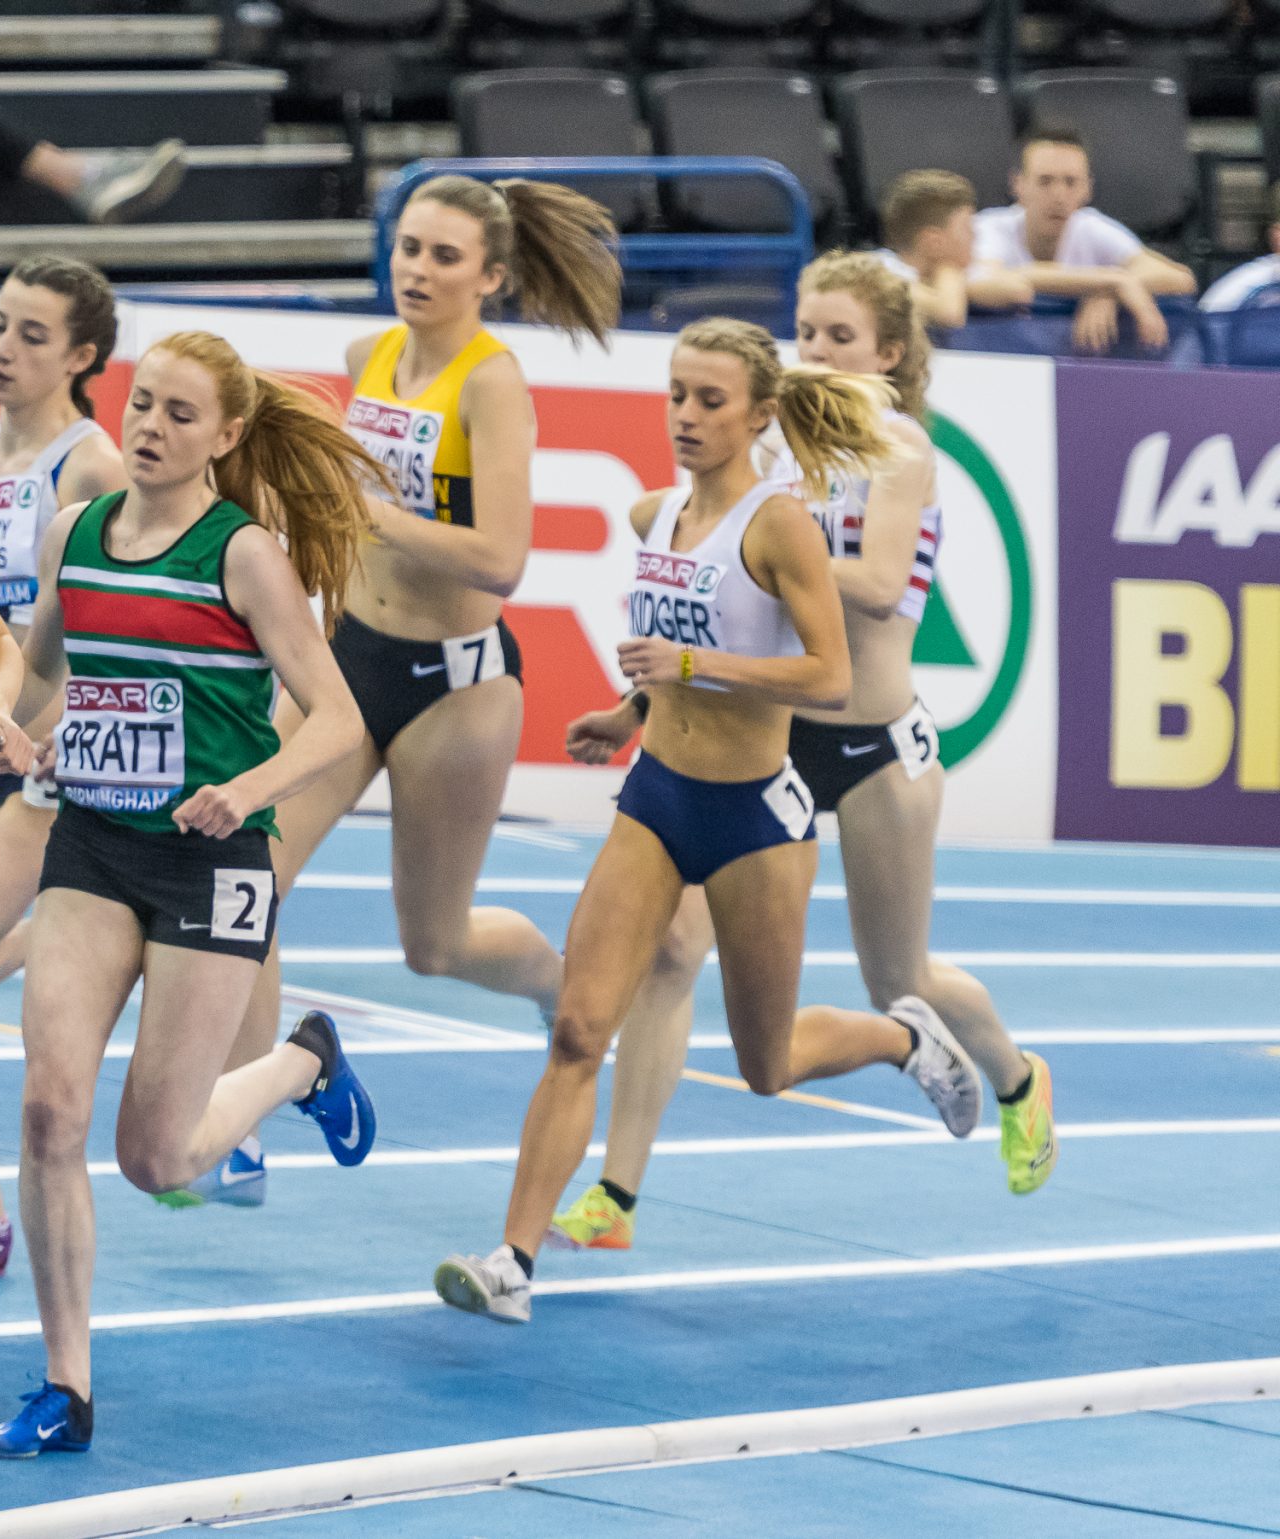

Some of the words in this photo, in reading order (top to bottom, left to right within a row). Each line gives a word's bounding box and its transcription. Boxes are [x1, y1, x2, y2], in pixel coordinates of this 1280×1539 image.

[638, 556, 695, 584] SPAR
[463, 638, 487, 685] 7
[67, 684, 145, 708] SPAR
[63, 721, 175, 773] PRATT
[911, 722, 930, 762] 5
[230, 881, 257, 930] 2
